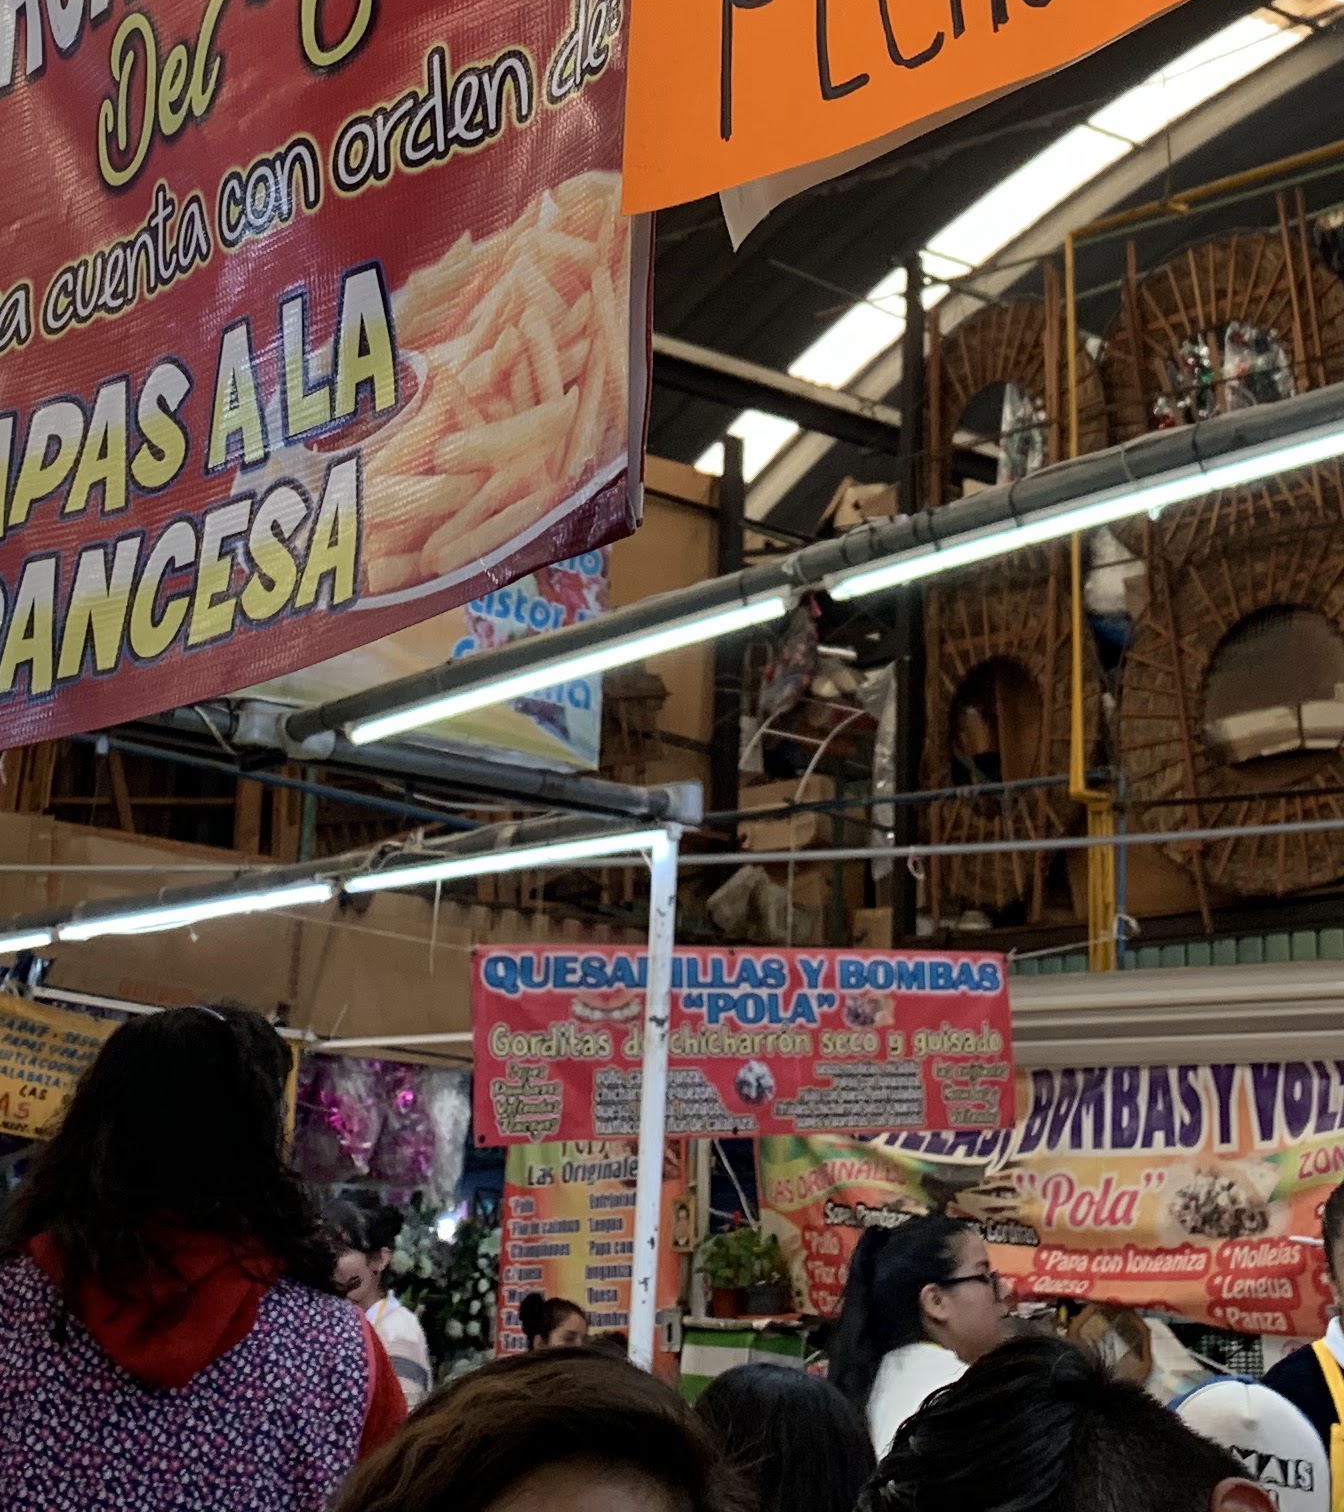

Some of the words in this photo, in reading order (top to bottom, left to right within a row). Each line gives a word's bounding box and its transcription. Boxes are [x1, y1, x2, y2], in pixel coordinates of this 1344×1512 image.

[42, 187, 209, 338] cuenta
[218, 137, 319, 245] con
[333, 48, 534, 193] orden
[205, 321, 268, 477] A
[278, 258, 400, 448] LA
[797, 958, 826, 989] Y
[837, 959, 1002, 992] BOMBAS
[490, 1022, 613, 1059] Gorditas
[820, 1028, 879, 1054] seco
[886, 1031, 904, 1057] y
[912, 1020, 1004, 1056] guisado
[1017, 1065, 1203, 1154] BOMBAS
[1207, 1061, 1240, 1145] Y
[526, 1164, 555, 1187] Las
[1090, 1254, 1124, 1273] con
[1125, 1249, 1206, 1273] longaniza
